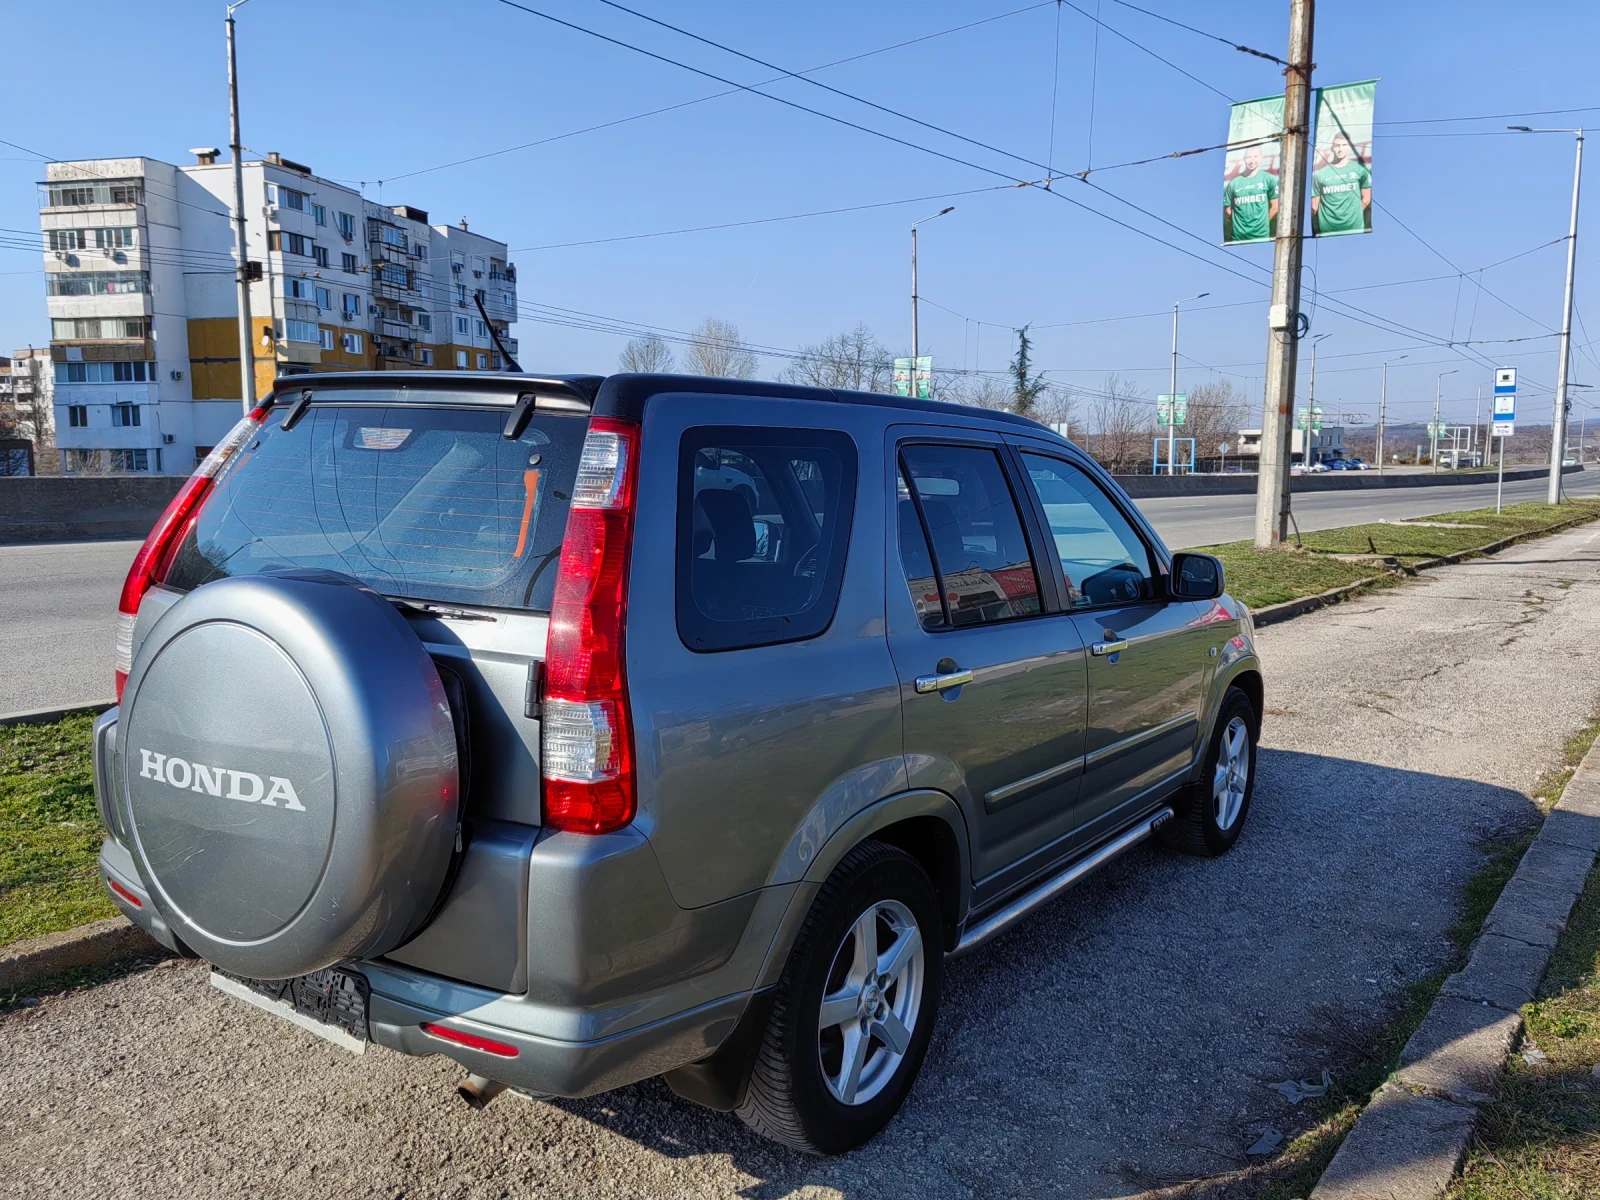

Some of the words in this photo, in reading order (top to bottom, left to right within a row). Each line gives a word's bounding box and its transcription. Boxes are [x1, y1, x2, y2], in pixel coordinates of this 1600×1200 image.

[1322, 182, 1358, 195] WINBET
[1234, 193, 1267, 205] WINBET
[139, 748, 306, 812] HONDA
